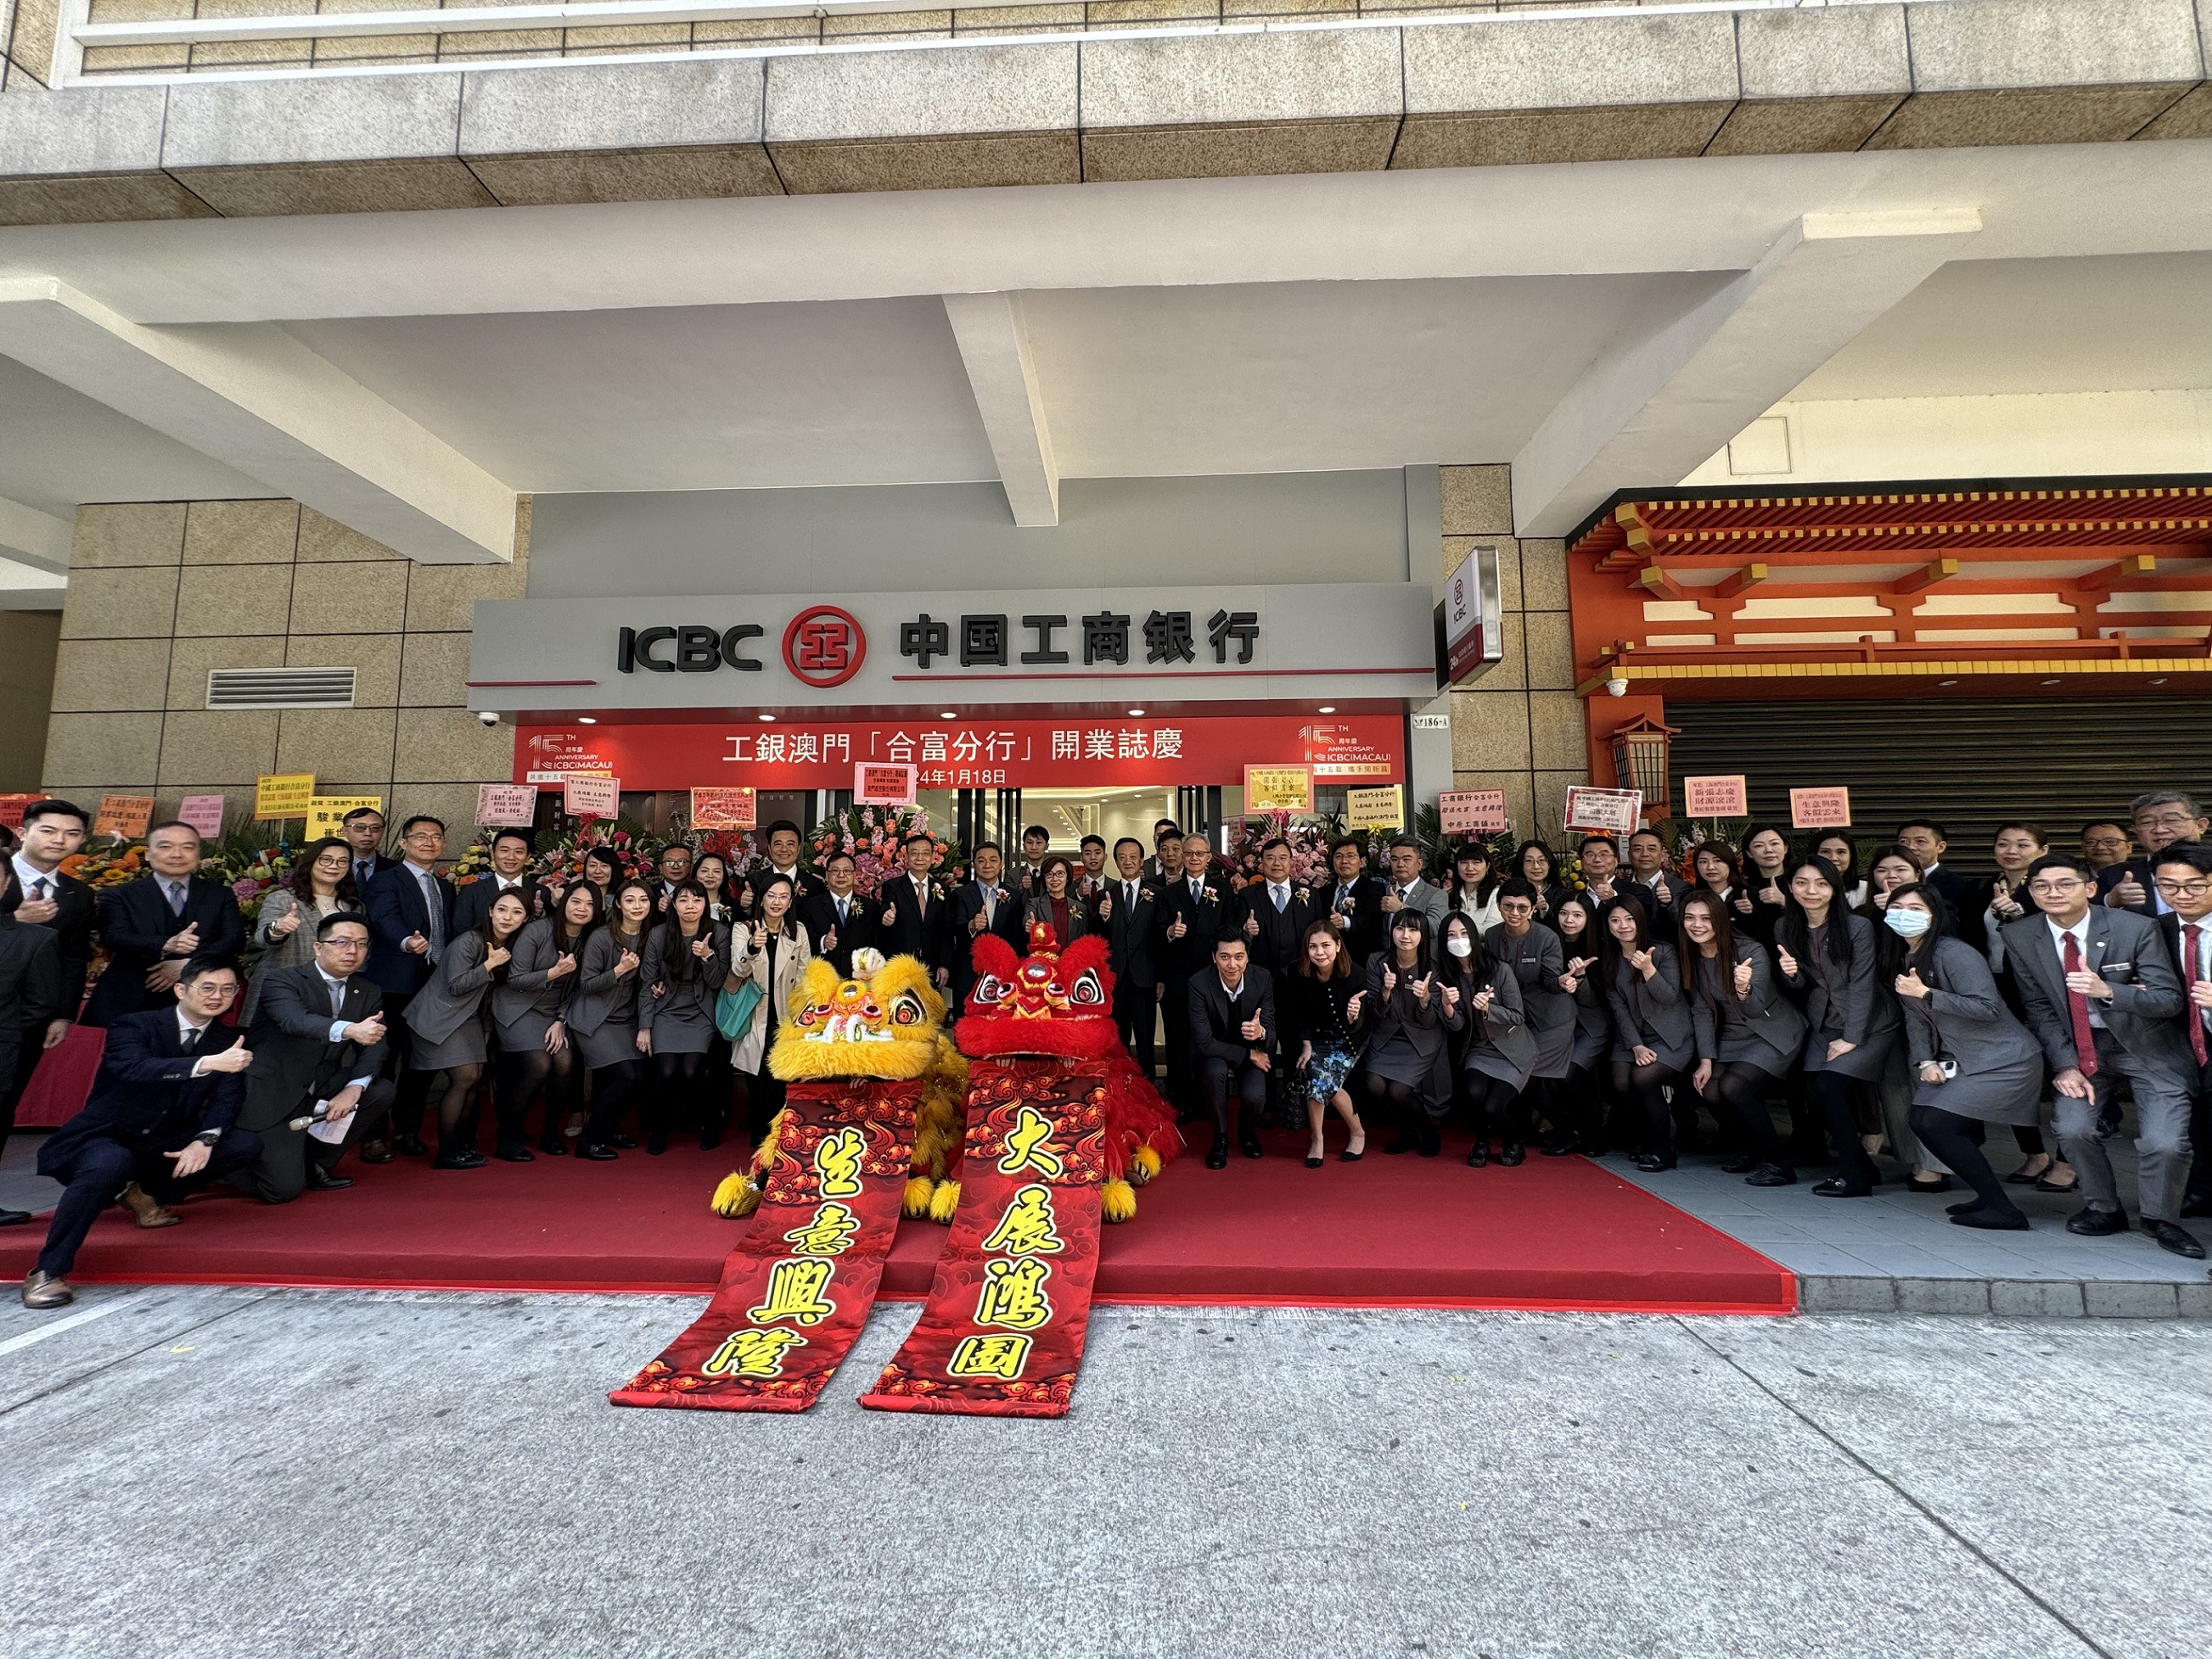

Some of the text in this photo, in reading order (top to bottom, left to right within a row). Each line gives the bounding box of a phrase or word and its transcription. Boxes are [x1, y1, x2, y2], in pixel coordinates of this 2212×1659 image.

[1453, 603, 1467, 625] ICBC
[617, 624, 764, 674] ICBC
[900, 608, 1260, 670] 中国工商银行
[553, 761, 613, 770] ICBC(MACAU)
[721, 727, 1184, 765] 工銀澳門「合富分行」開業誌慶
[1327, 753, 1391, 762] ICBC(MACAU)
[701, 1125, 867, 1380] 生意興隆
[946, 1106, 1063, 1381] 大展鴻圖
